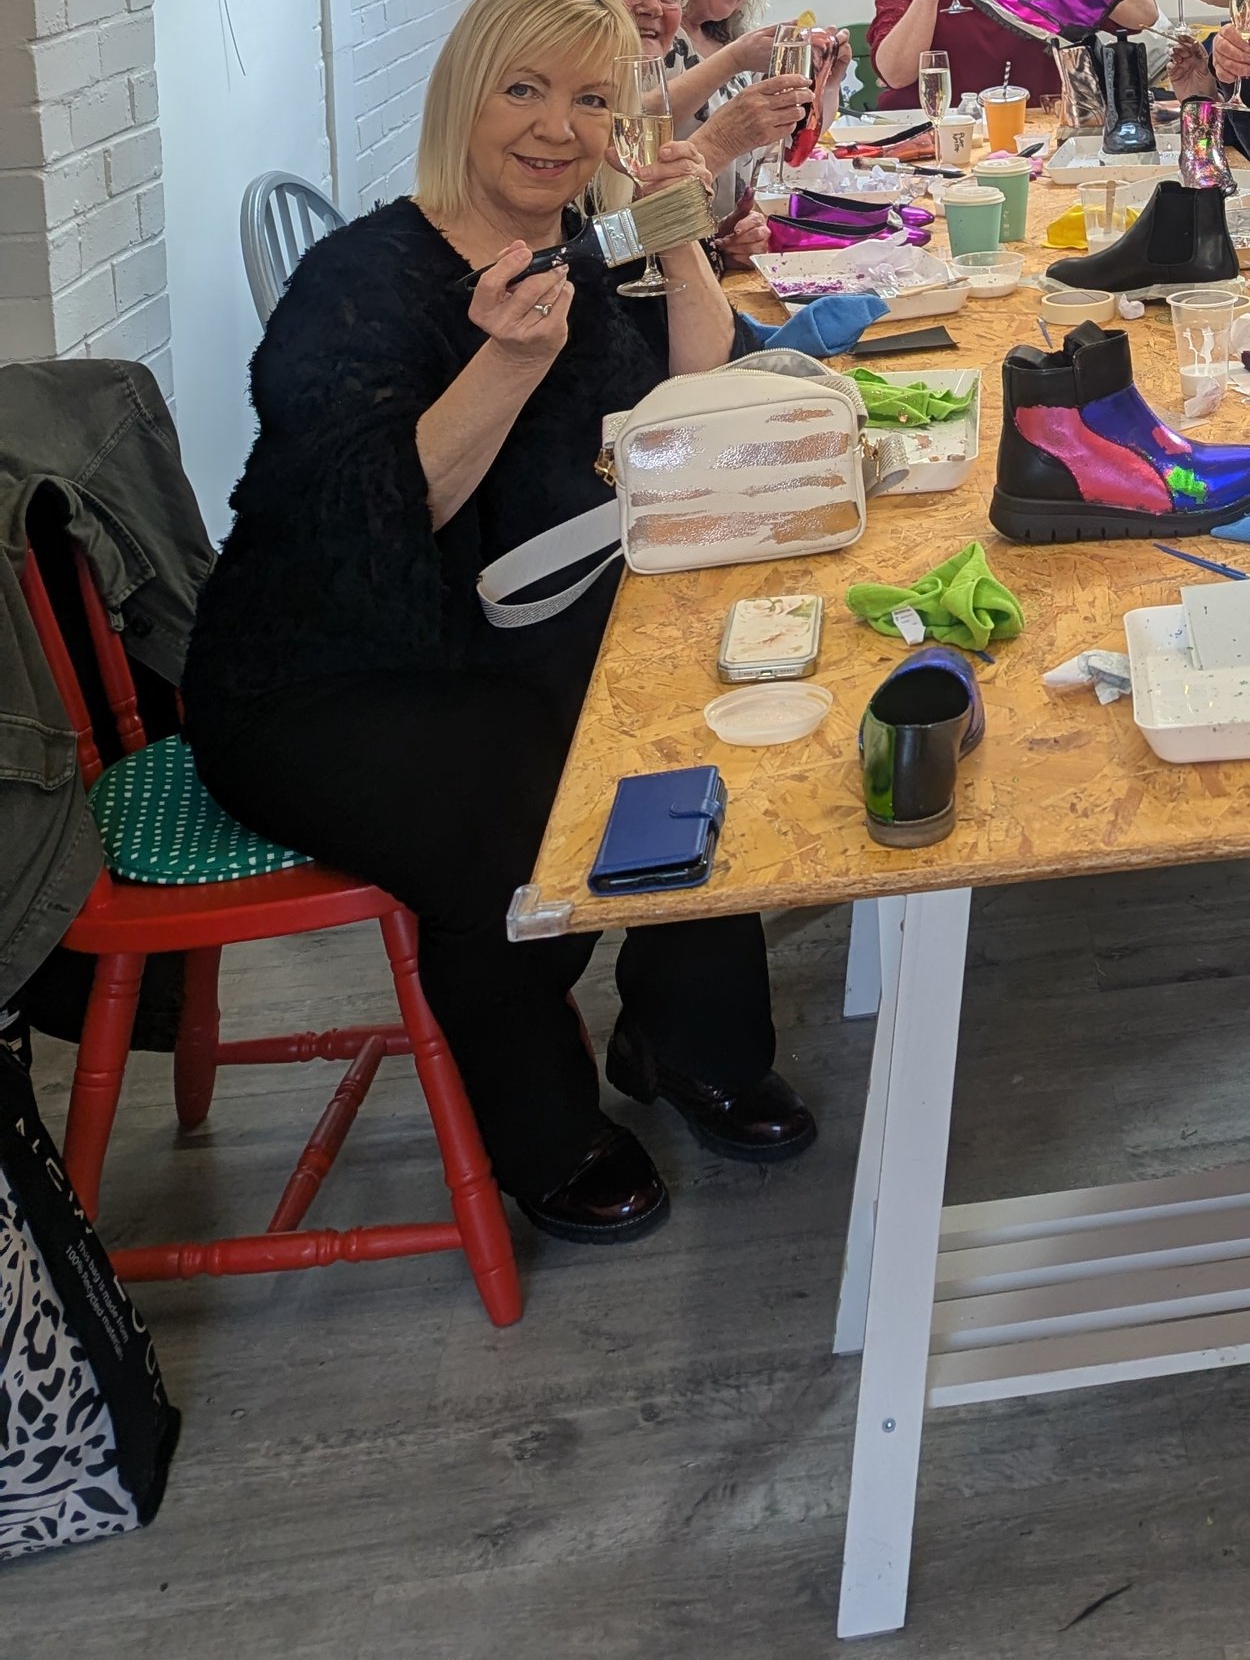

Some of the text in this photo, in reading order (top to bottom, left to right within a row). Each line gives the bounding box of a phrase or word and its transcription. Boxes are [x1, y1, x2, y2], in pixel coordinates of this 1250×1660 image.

[65, 1244, 83, 1275] 100%
[82, 1271, 104, 1317] Recycled
[77, 1239, 91, 1262] This
[88, 1259, 101, 1283] bag
[98, 1280, 106, 1292] is
[102, 1290, 118, 1318] made
[116, 1316, 129, 1344] from
